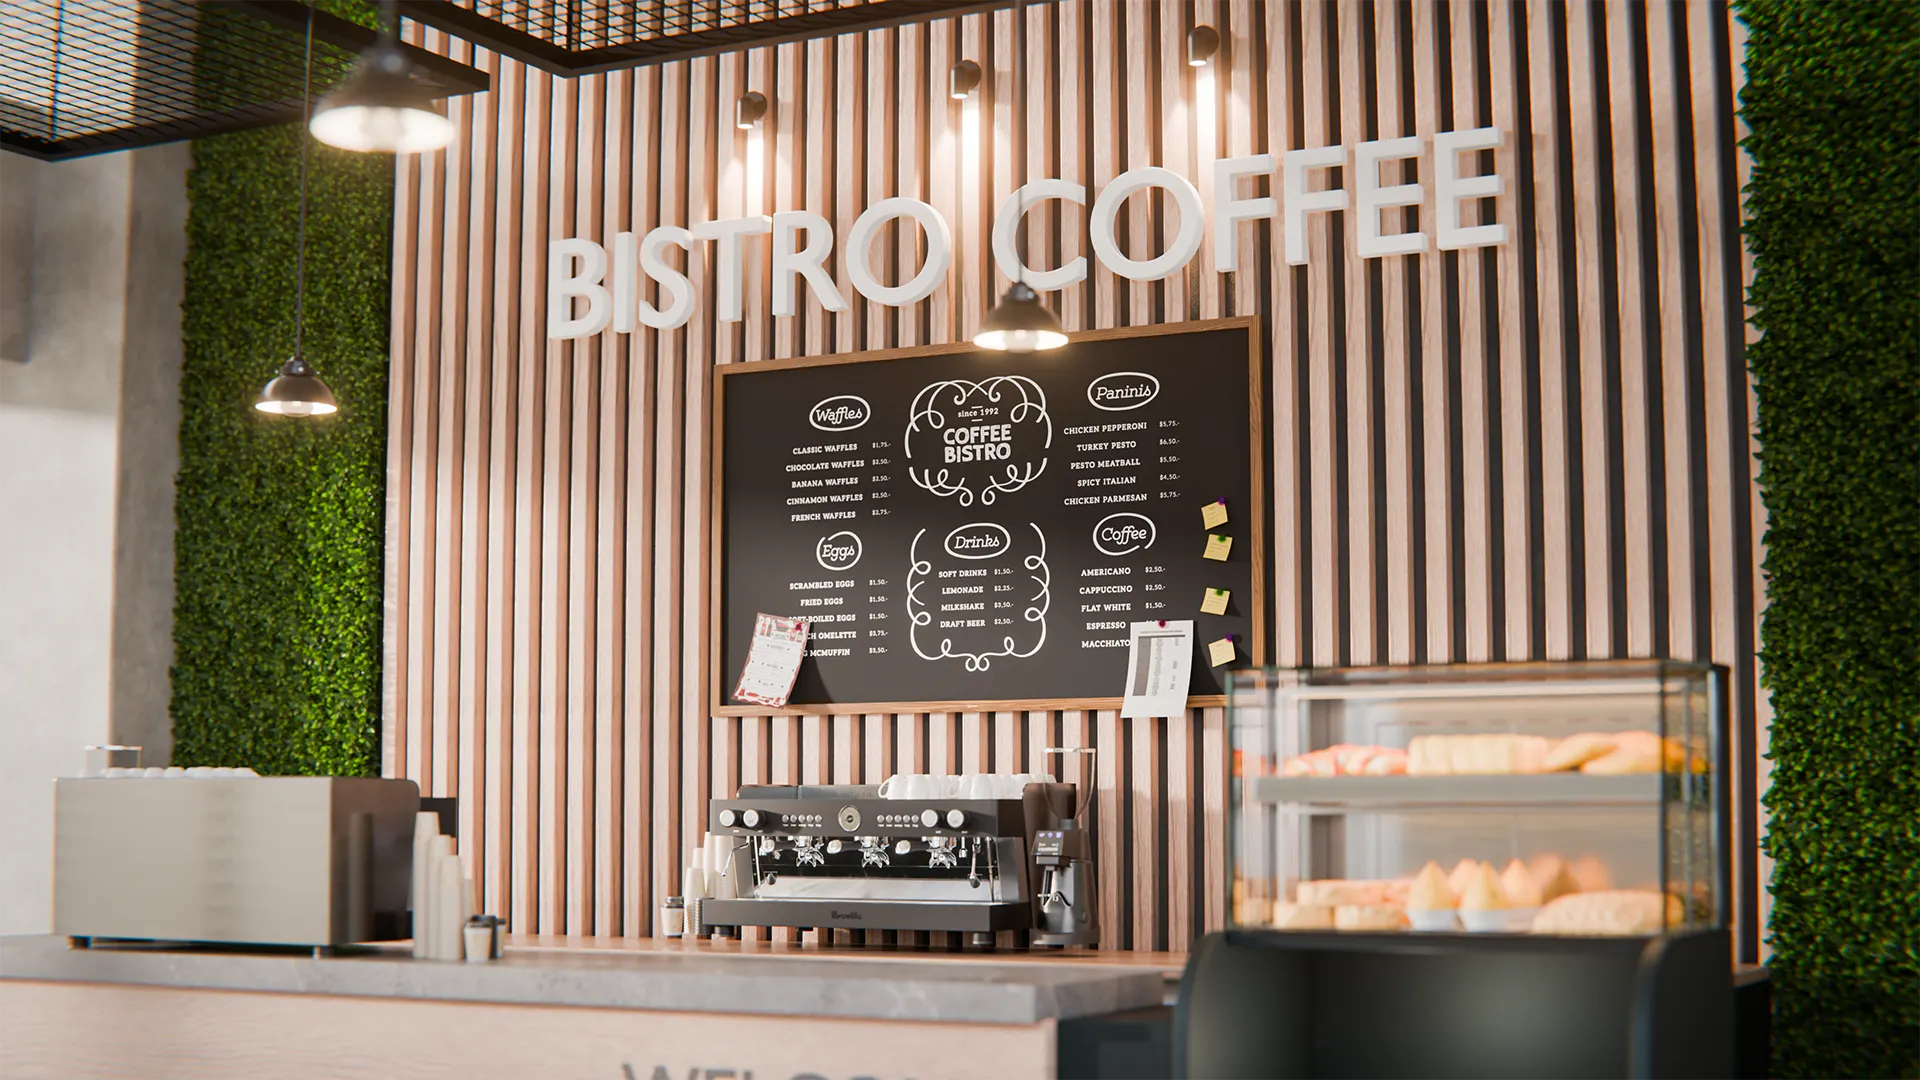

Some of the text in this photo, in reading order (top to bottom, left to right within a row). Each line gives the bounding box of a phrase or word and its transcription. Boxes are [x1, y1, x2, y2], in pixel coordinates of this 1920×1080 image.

[548, 126, 1508, 340] BISTRO COFFEE
[1096, 384, 1152, 401] Paninis
[816, 406, 863, 424] Waffles
[958, 408, 999, 418] since 1992
[1064, 426, 1100, 435] CHICKEN
[1102, 422, 1147, 432] PEPPERONI
[943, 424, 1012, 445] COFFEE
[792, 446, 822, 455] CLASSIC
[824, 444, 858, 452] WAFFLES
[1077, 442, 1109, 452] TURKEY
[1111, 441, 1136, 450] PESTO
[944, 442, 1012, 464] BISTRO
[786, 462, 829, 472] CHOCOLATE
[831, 460, 865, 469] WAFFLES
[1070, 461, 1096, 470] PESTO
[1098, 458, 1140, 468] MEATBALL
[792, 479, 823, 488] BANANA
[825, 477, 858, 486] WAFFLES
[1077, 478, 1100, 487] SPICY
[1102, 476, 1136, 486] ITALIAN
[786, 496, 828, 505] CINNAMON
[830, 494, 863, 503] WAFFLES
[1064, 496, 1100, 505] CHICKEN
[1102, 494, 1147, 503] PARMESAN
[791, 513, 820, 522] FRENCH
[822, 511, 856, 520] WAFFLES
[1101, 525, 1147, 545] Coffee
[954, 534, 1000, 549] Drinks
[822, 544, 855, 562] Eggs
[959, 569, 987, 577] DRINKS
[1081, 567, 1131, 577] AMERICANO
[789, 581, 833, 590] SCRAMBLED
[942, 586, 984, 594] LEMONADE
[1079, 585, 1133, 595] CAPPUCCINO
[941, 603, 984, 611] MILKSHAKE
[1081, 604, 1101, 612] FLAT
[1104, 603, 1131, 612] WHITE
[1086, 621, 1126, 630] ESPRESSO
[818, 631, 857, 639] OMELETTE
[1081, 639, 1131, 648] MACCHIATO
[810, 649, 850, 657] MCMUFFIN
